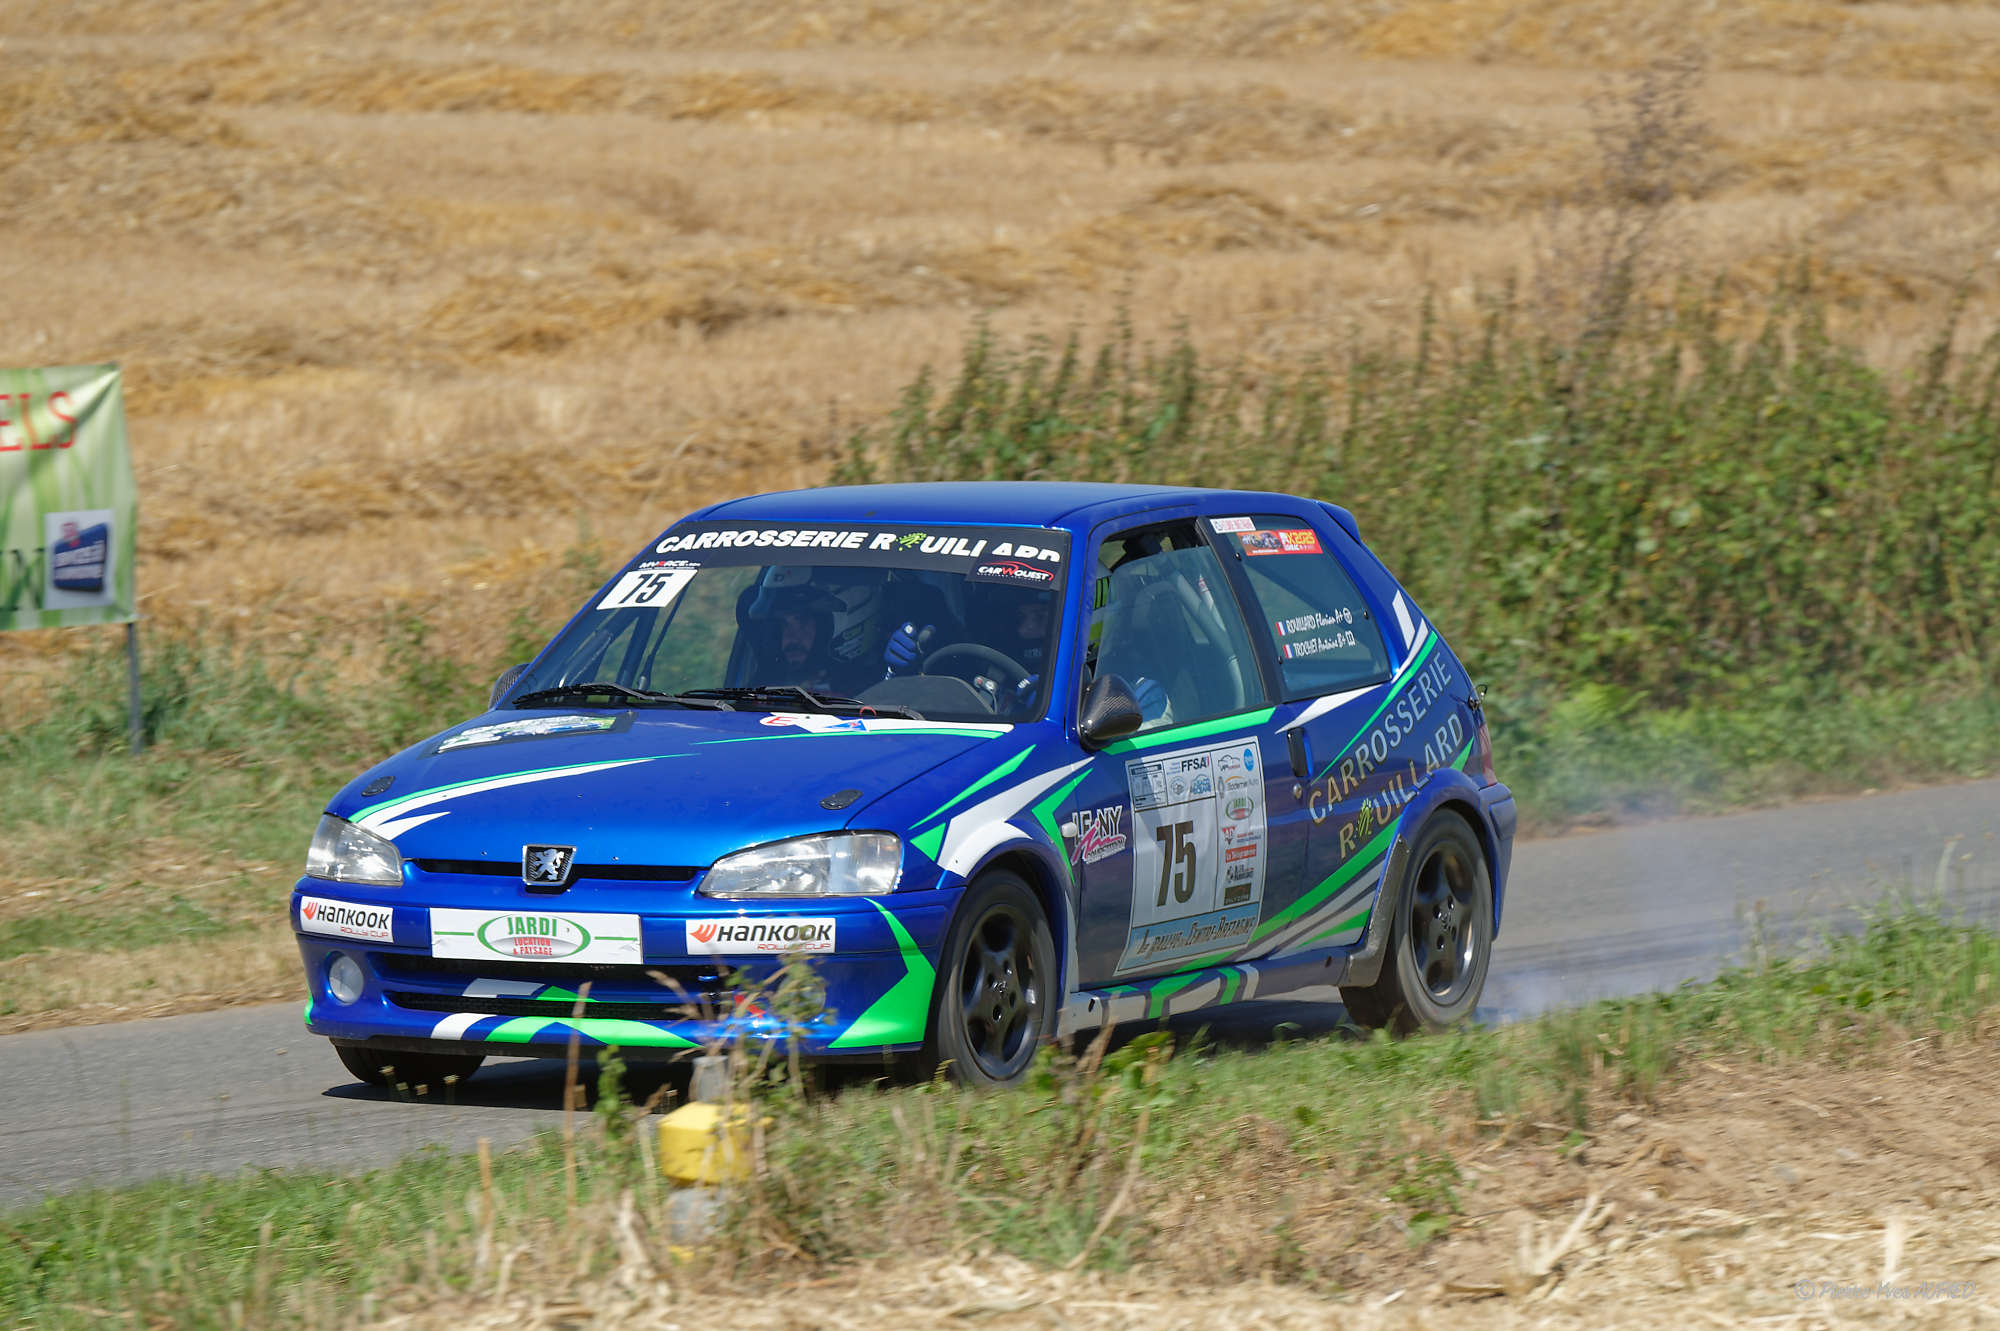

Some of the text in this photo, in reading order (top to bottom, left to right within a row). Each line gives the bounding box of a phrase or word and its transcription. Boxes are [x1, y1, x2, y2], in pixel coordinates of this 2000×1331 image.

[655, 530, 869, 554] CARROSSERIE
[618, 573, 674, 604] 75
[1308, 651, 1452, 824] CARROSSERIE
[1181, 756, 1206, 772] FFSA
[1156, 820, 1197, 907] 75
[507, 916, 557, 937] JARDI
[513, 937, 551, 946] LOCATION
[520, 946, 552, 956] PAYSAGE
